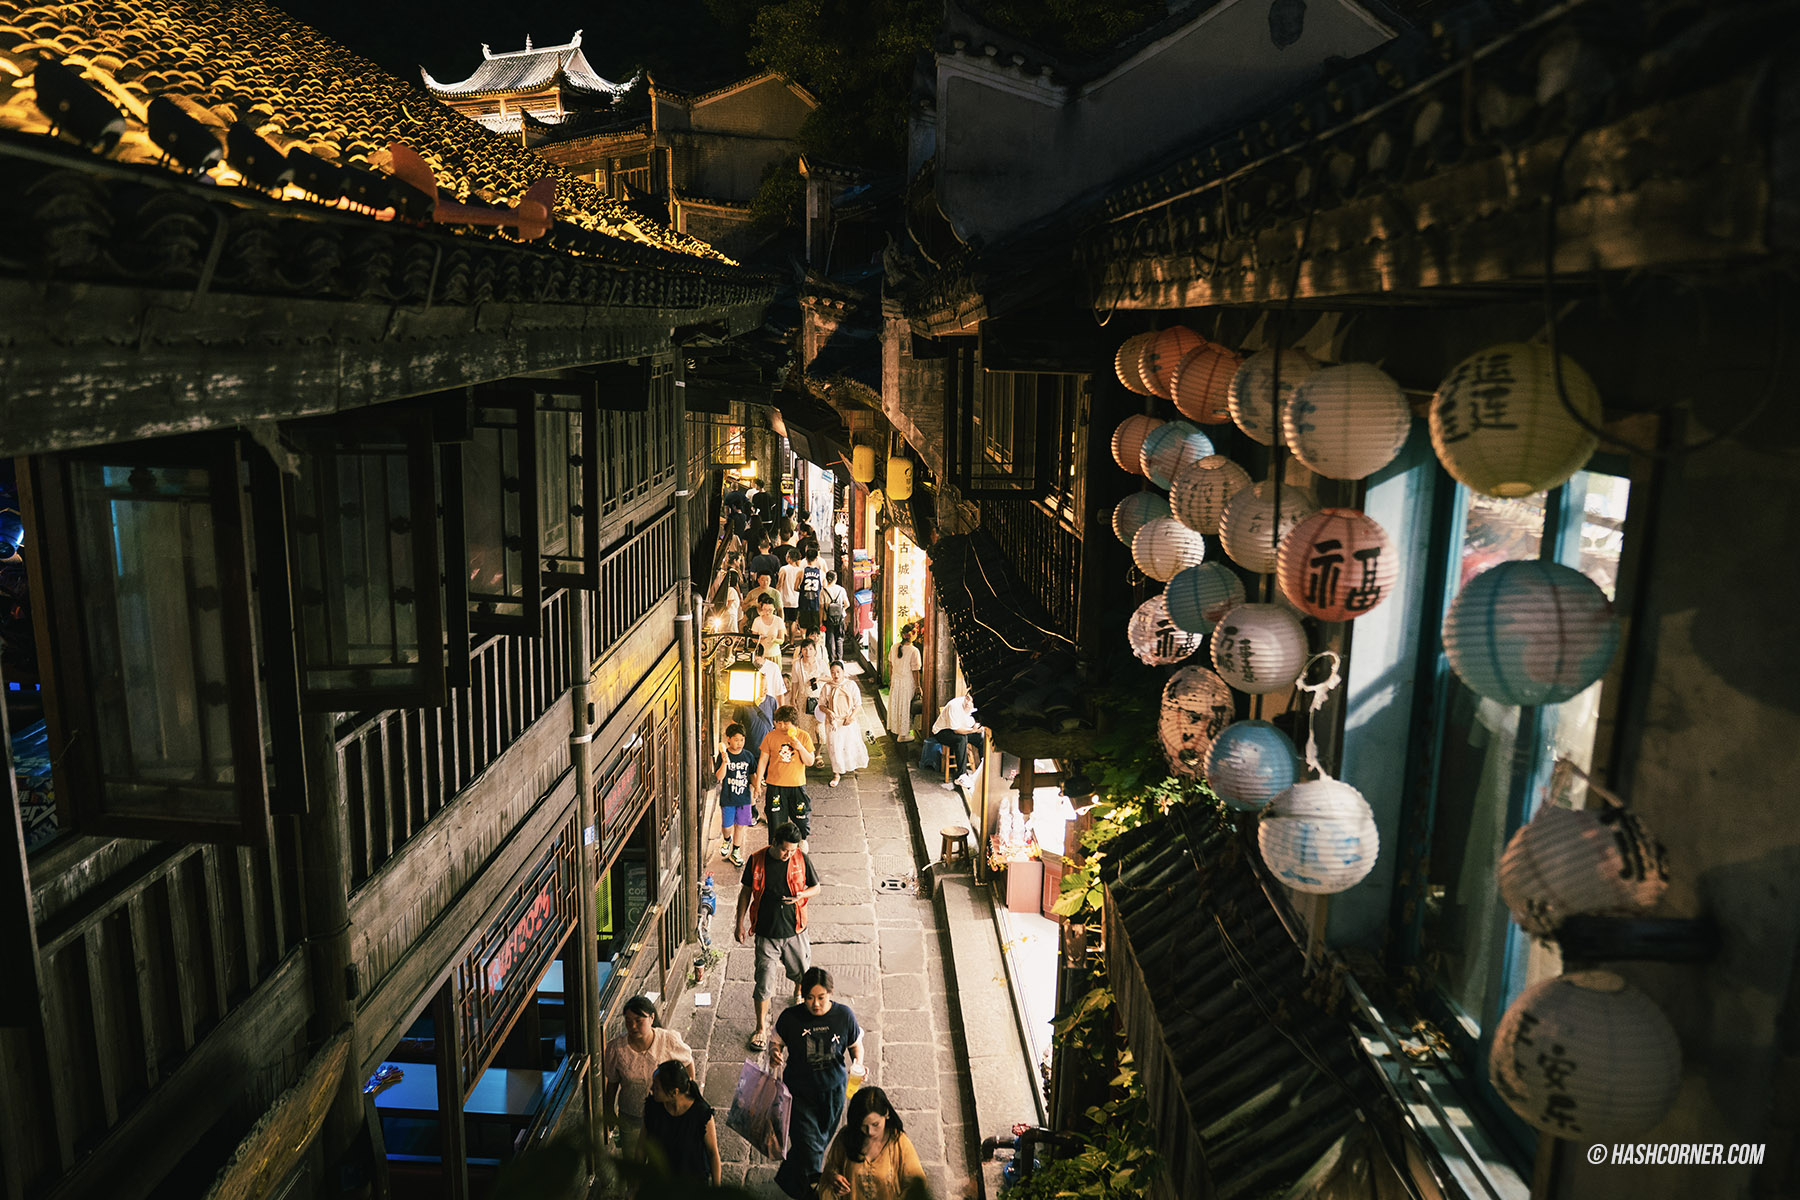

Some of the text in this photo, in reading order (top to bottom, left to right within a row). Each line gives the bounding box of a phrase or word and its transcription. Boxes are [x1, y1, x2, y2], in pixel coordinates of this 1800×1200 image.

[804, 579, 819, 592] 23
[898, 542, 910, 617] 古城翠茶
